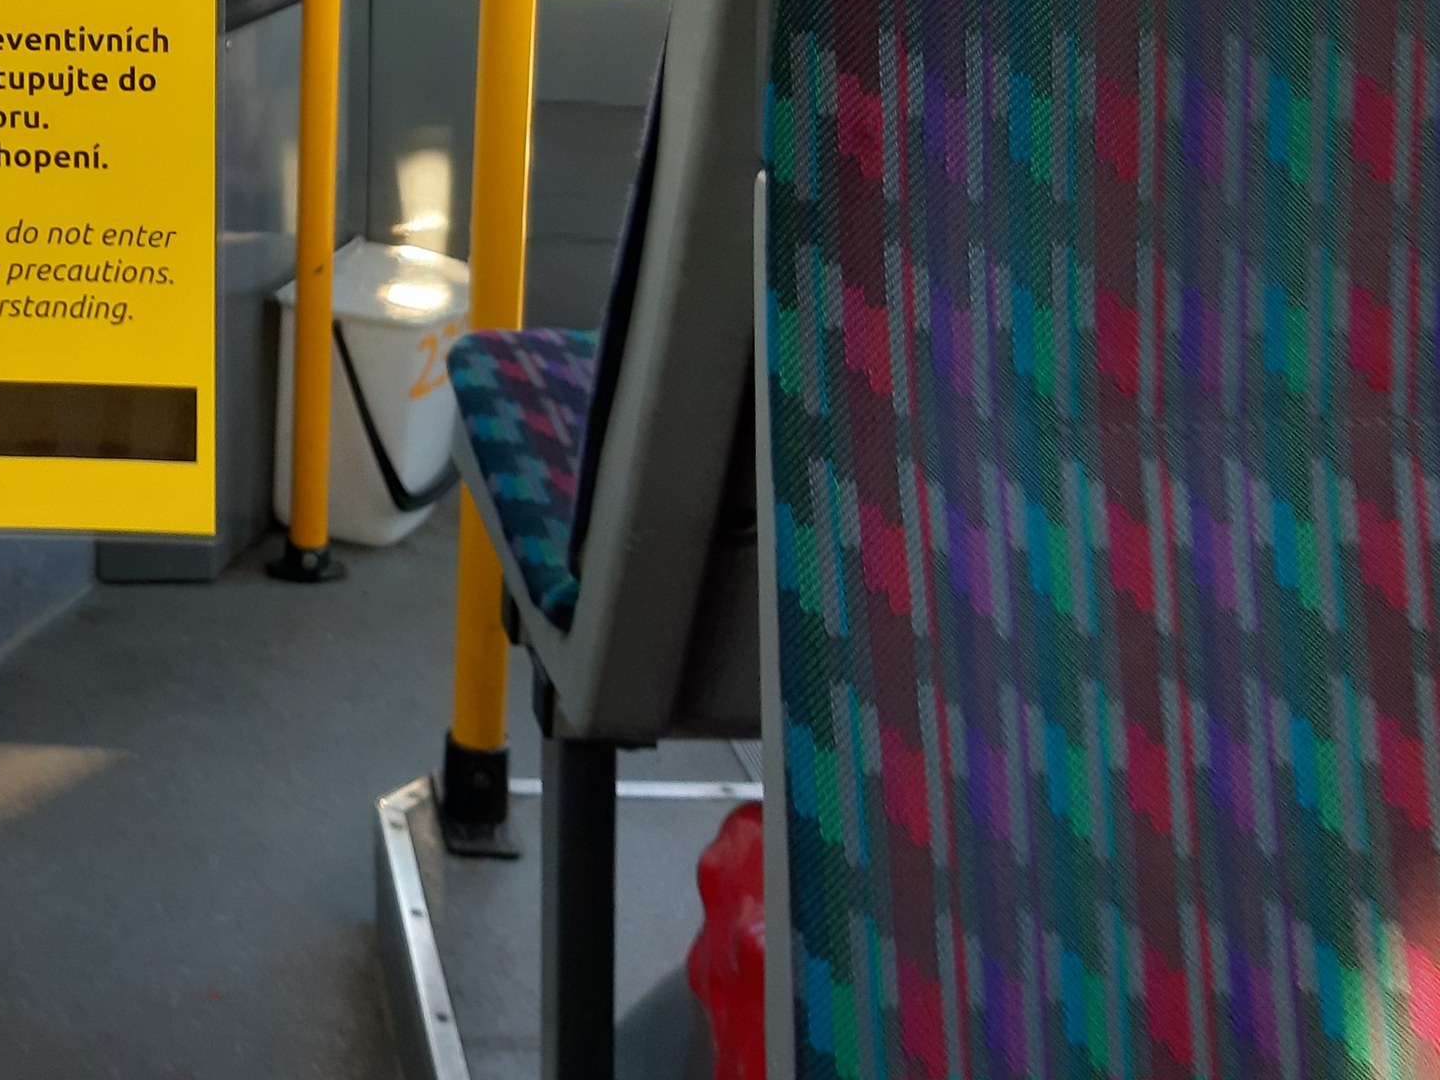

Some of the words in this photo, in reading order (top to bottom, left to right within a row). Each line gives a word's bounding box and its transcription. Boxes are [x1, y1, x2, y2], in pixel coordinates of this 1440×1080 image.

[118, 65, 157, 92] do
[5, 219, 39, 244] do
[47, 223, 94, 245] not
[102, 225, 177, 248] enter
[6, 259, 173, 285] precautions.
